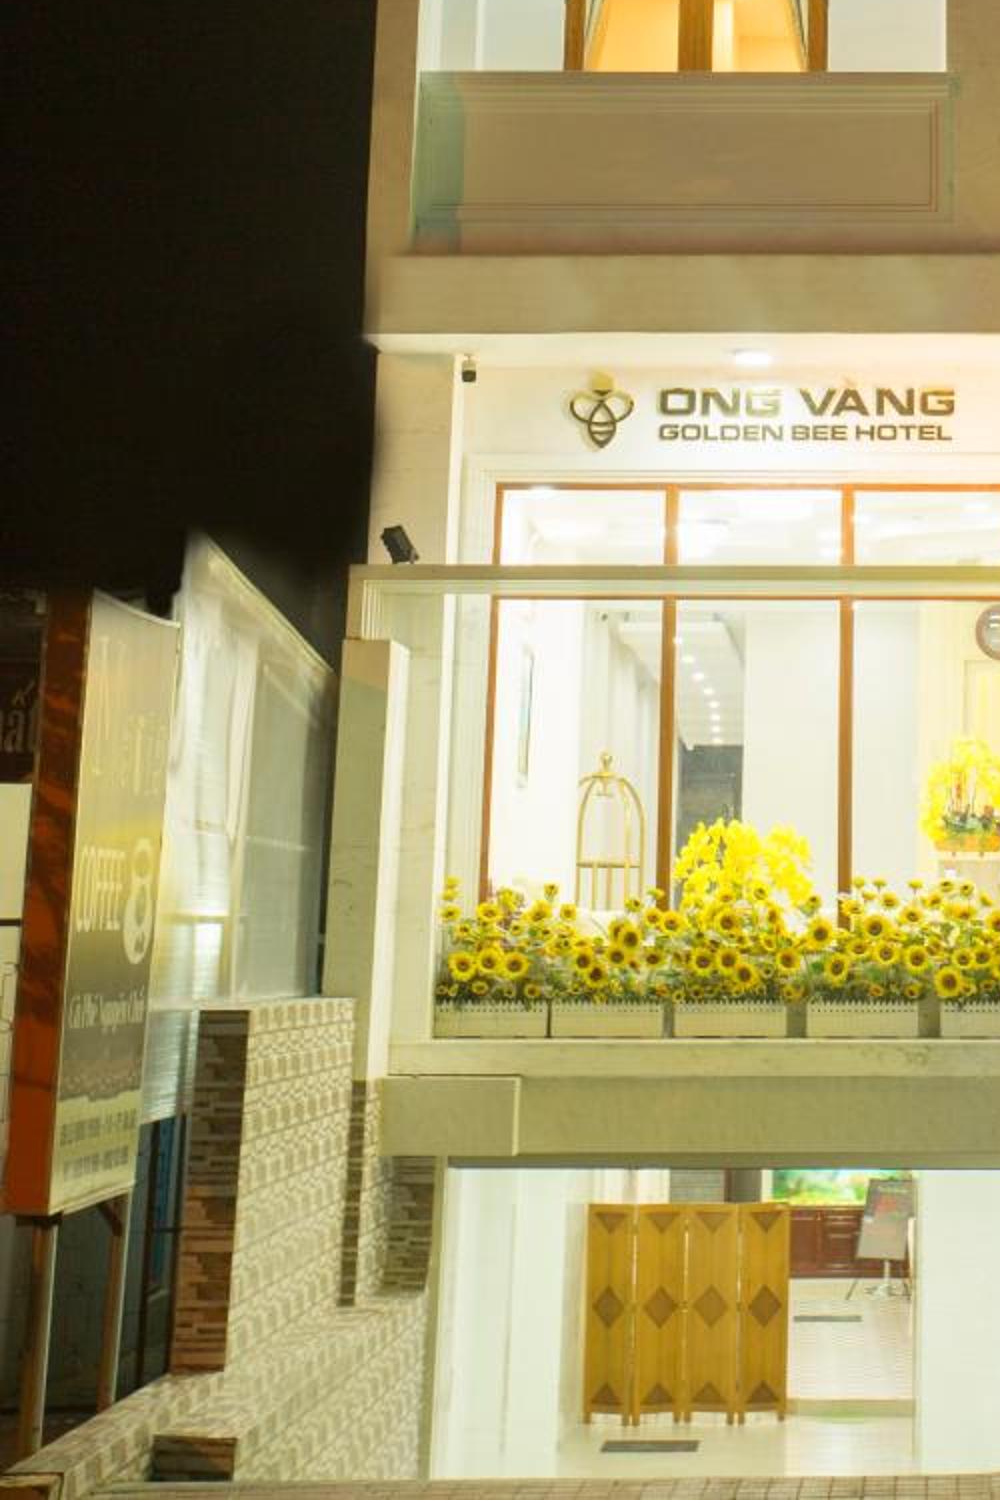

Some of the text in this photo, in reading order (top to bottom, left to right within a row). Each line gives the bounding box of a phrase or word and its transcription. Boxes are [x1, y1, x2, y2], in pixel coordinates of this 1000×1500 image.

[659, 387, 784, 418] ONG
[658, 423, 953, 442] GOLDEN BEE HOTEL
[75, 844, 126, 932] COFFEE
